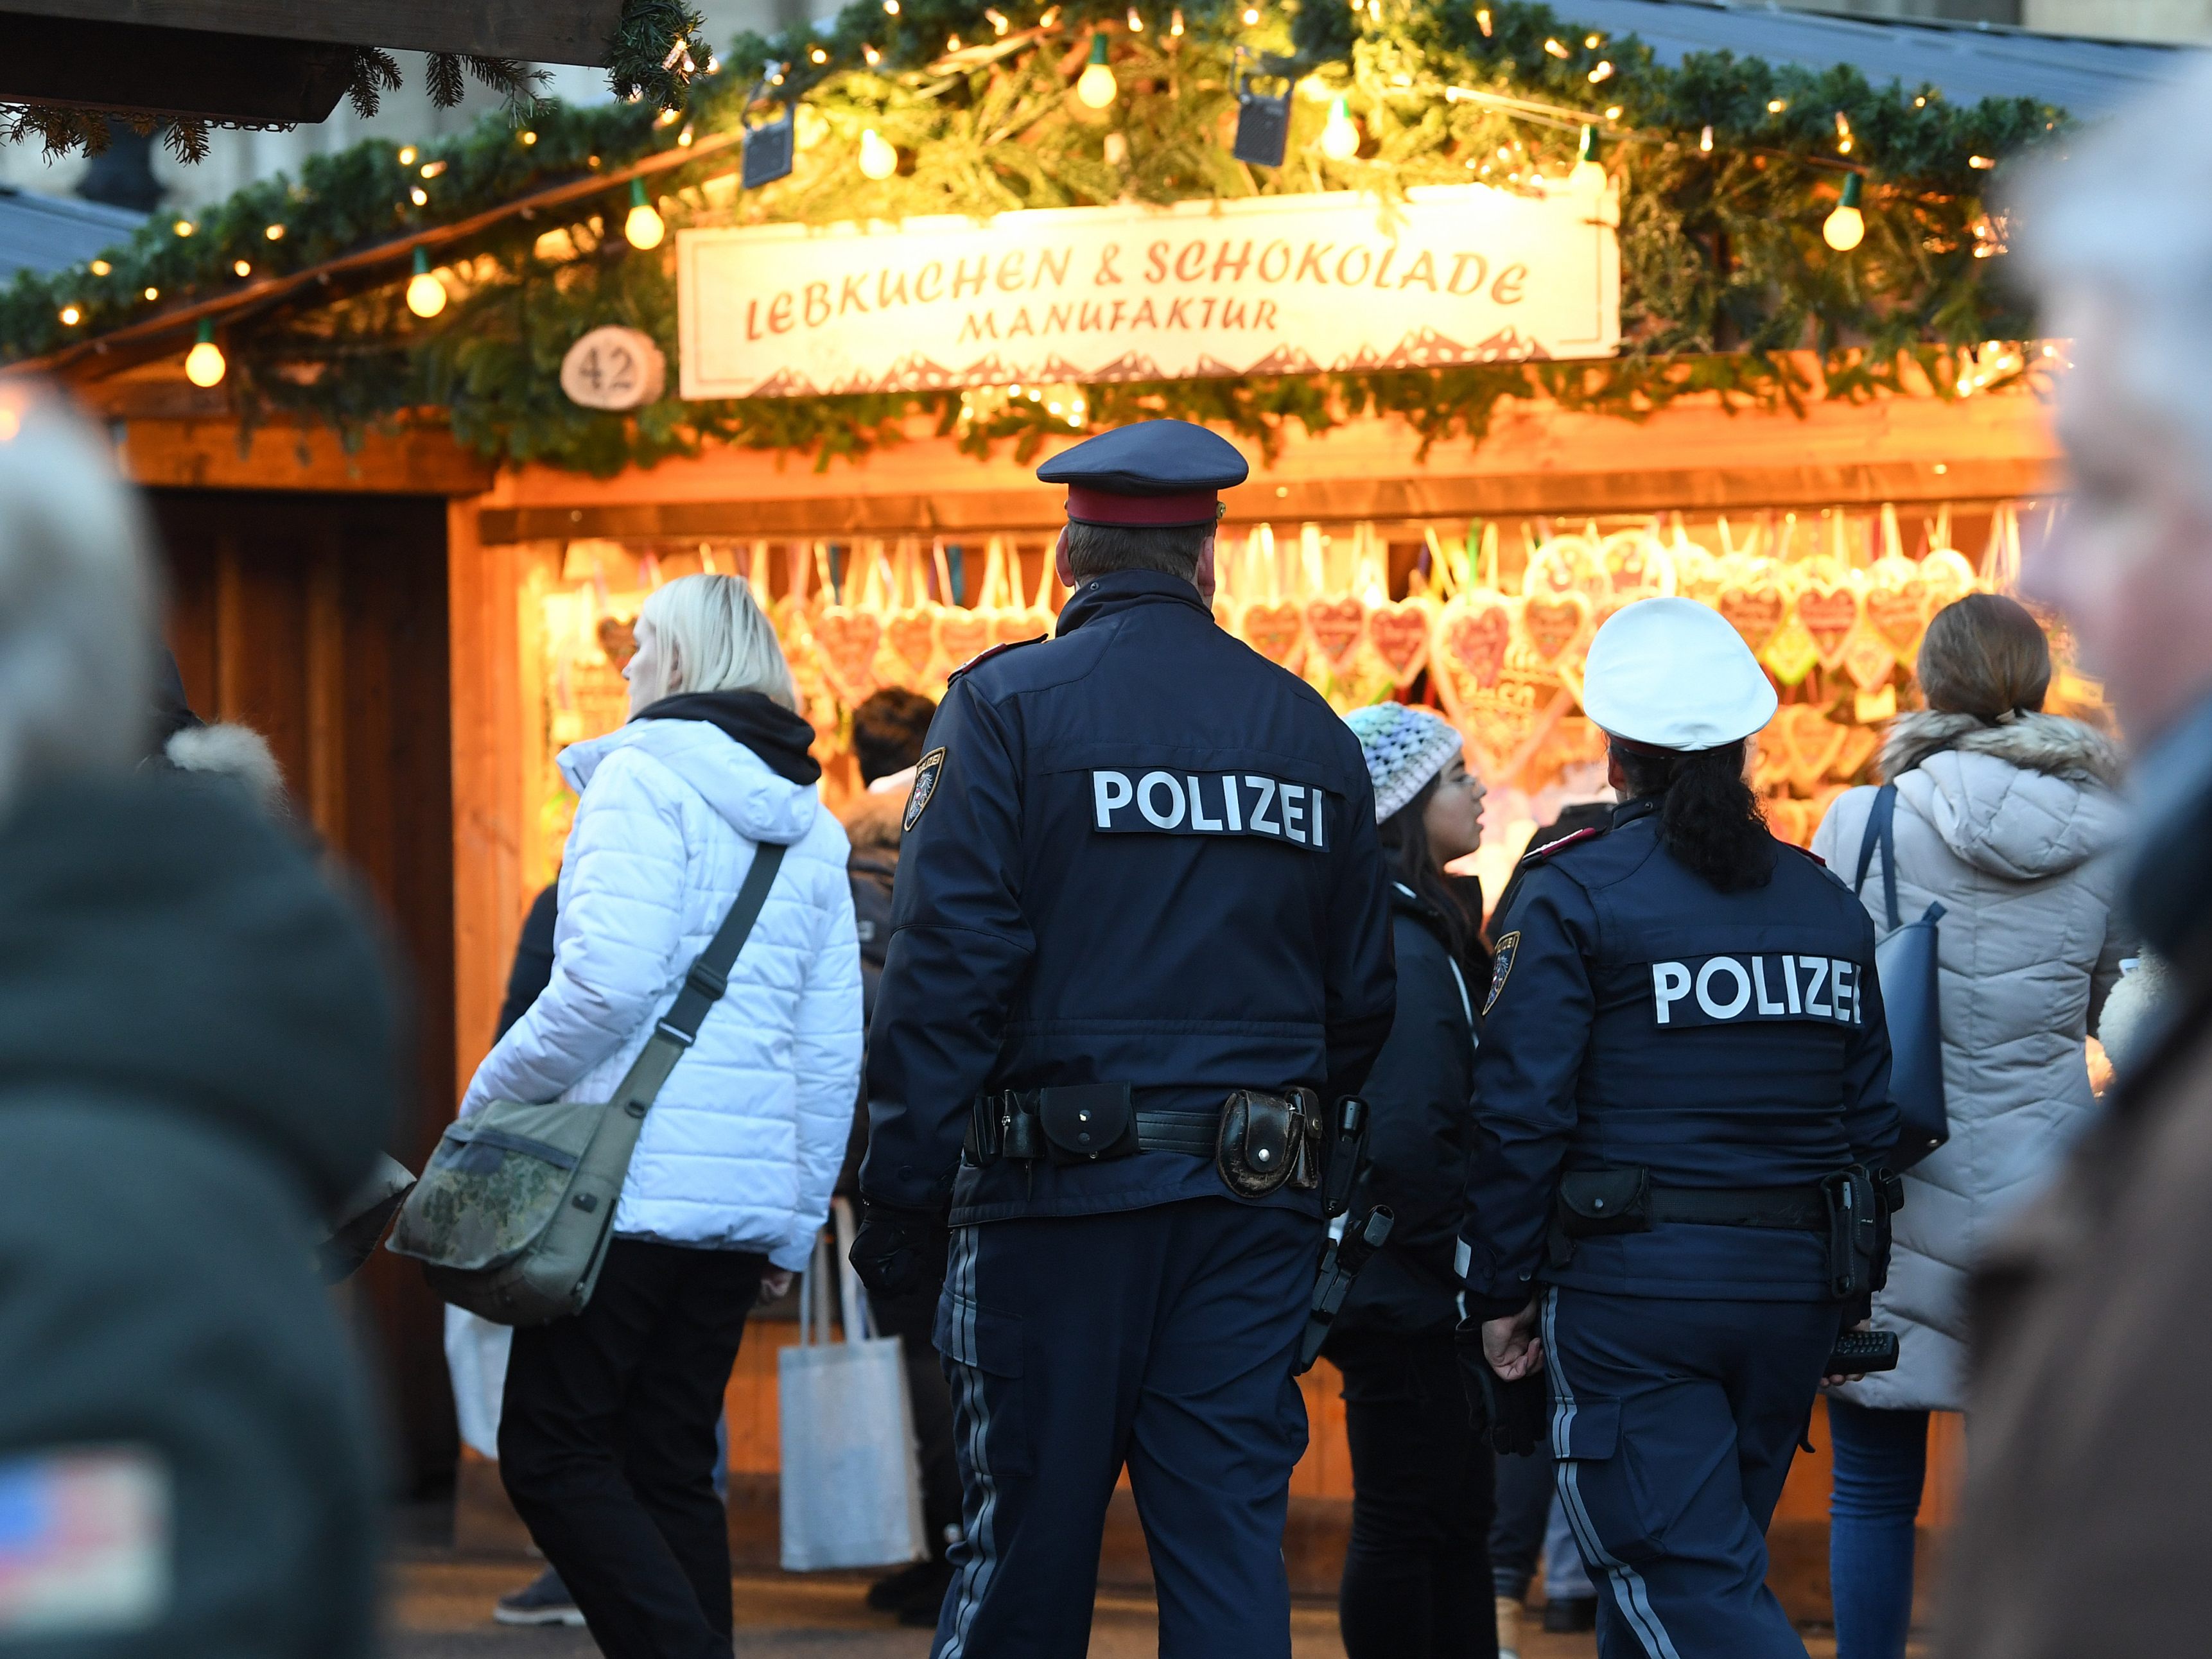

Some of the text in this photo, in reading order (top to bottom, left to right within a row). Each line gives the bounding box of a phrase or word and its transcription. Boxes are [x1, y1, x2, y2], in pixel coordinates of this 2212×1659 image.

[745, 238, 1529, 342] LEBKUCHEN & SCHOKOLADE
[957, 297, 1278, 344] MANUFAKTUR
[579, 345, 633, 390] 42
[1093, 770, 1323, 847] POLIZEI
[1652, 955, 1861, 1024] POLIZEI
